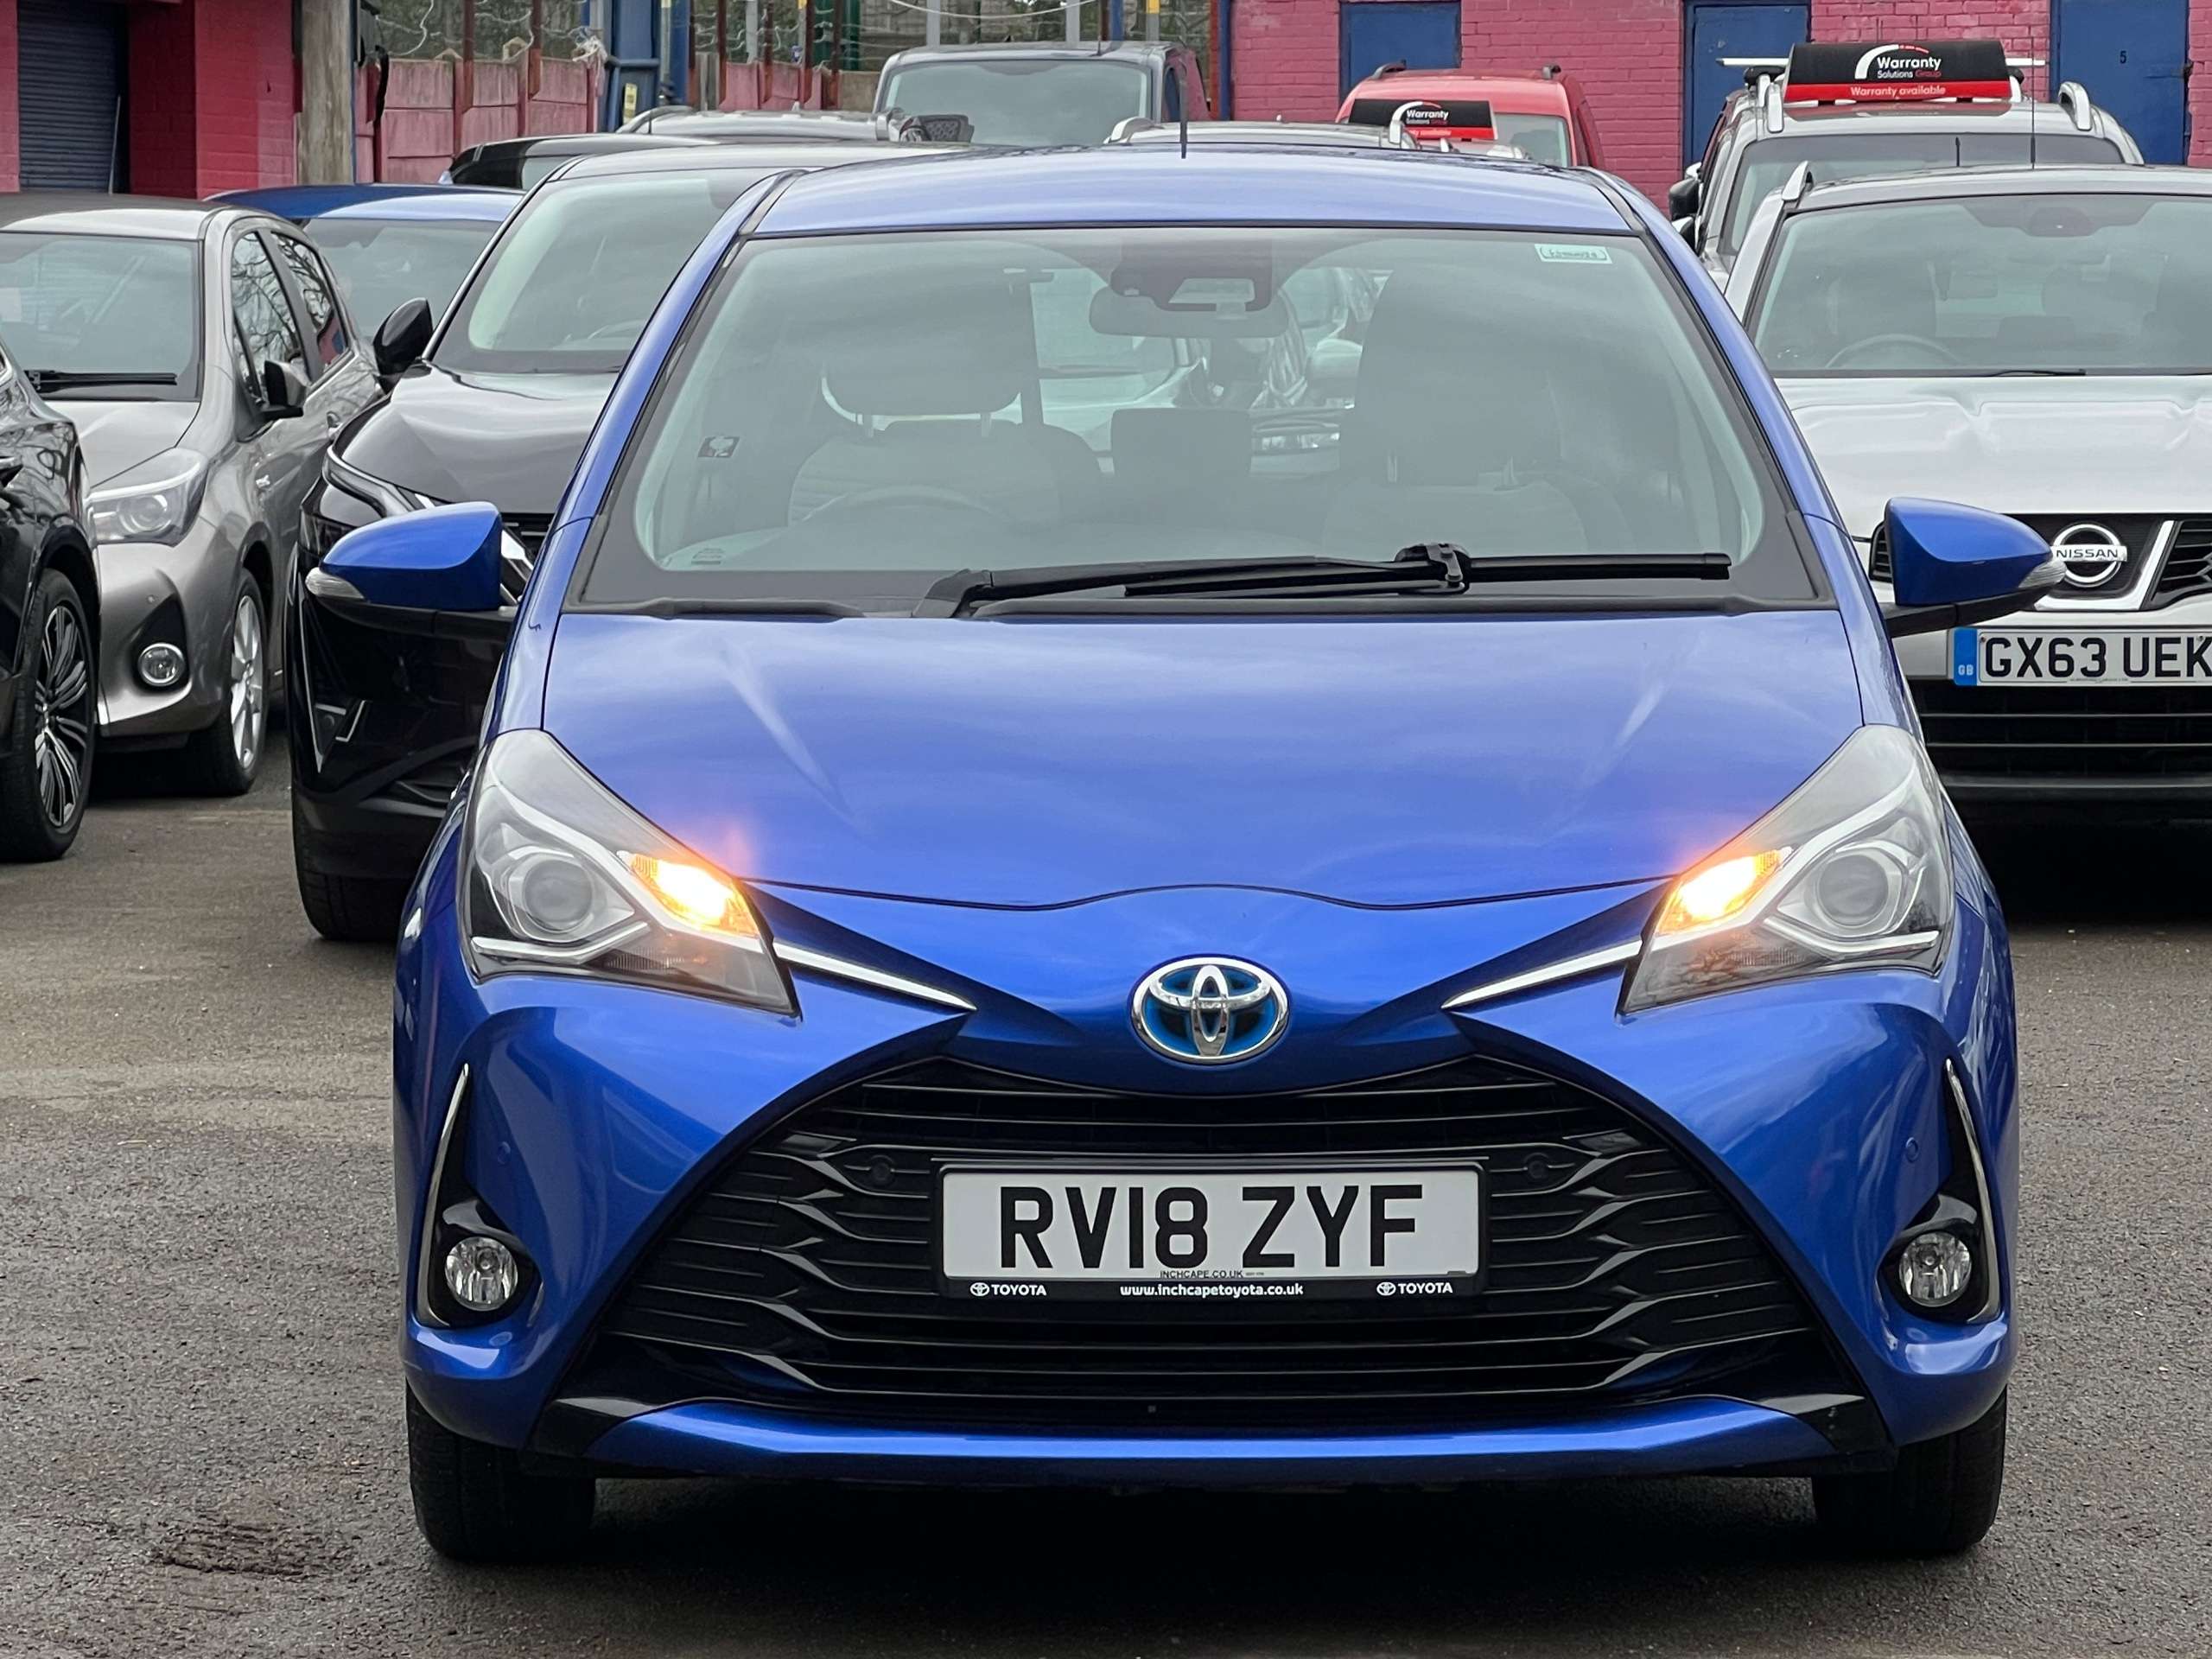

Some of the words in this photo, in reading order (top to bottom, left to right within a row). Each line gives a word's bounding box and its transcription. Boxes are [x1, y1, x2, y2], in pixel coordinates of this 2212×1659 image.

[1877, 56, 1942, 71] Warranty
[2120, 50, 2126, 64] 5
[1877, 70, 1913, 79] Solutions
[1850, 86, 1897, 98] Warranty
[1899, 85, 1946, 96] available
[1406, 109, 1449, 120] Warranty
[2056, 549, 2118, 559] NISSAN
[1985, 637, 2107, 677] GX63
[2123, 637, 2212, 677] UEK
[1957, 664, 1974, 676] GB
[1000, 1185, 1208, 1268] RV18
[1242, 1184, 1423, 1268] ZYF
[1160, 1269, 1243, 1279] INCHCAPE.CO.UK
[991, 1284, 1047, 1296] TOYOTA
[1120, 1283, 1304, 1299] www.inchcapetoyota.co.uk
[1397, 1281, 1453, 1294] TOYOTA
